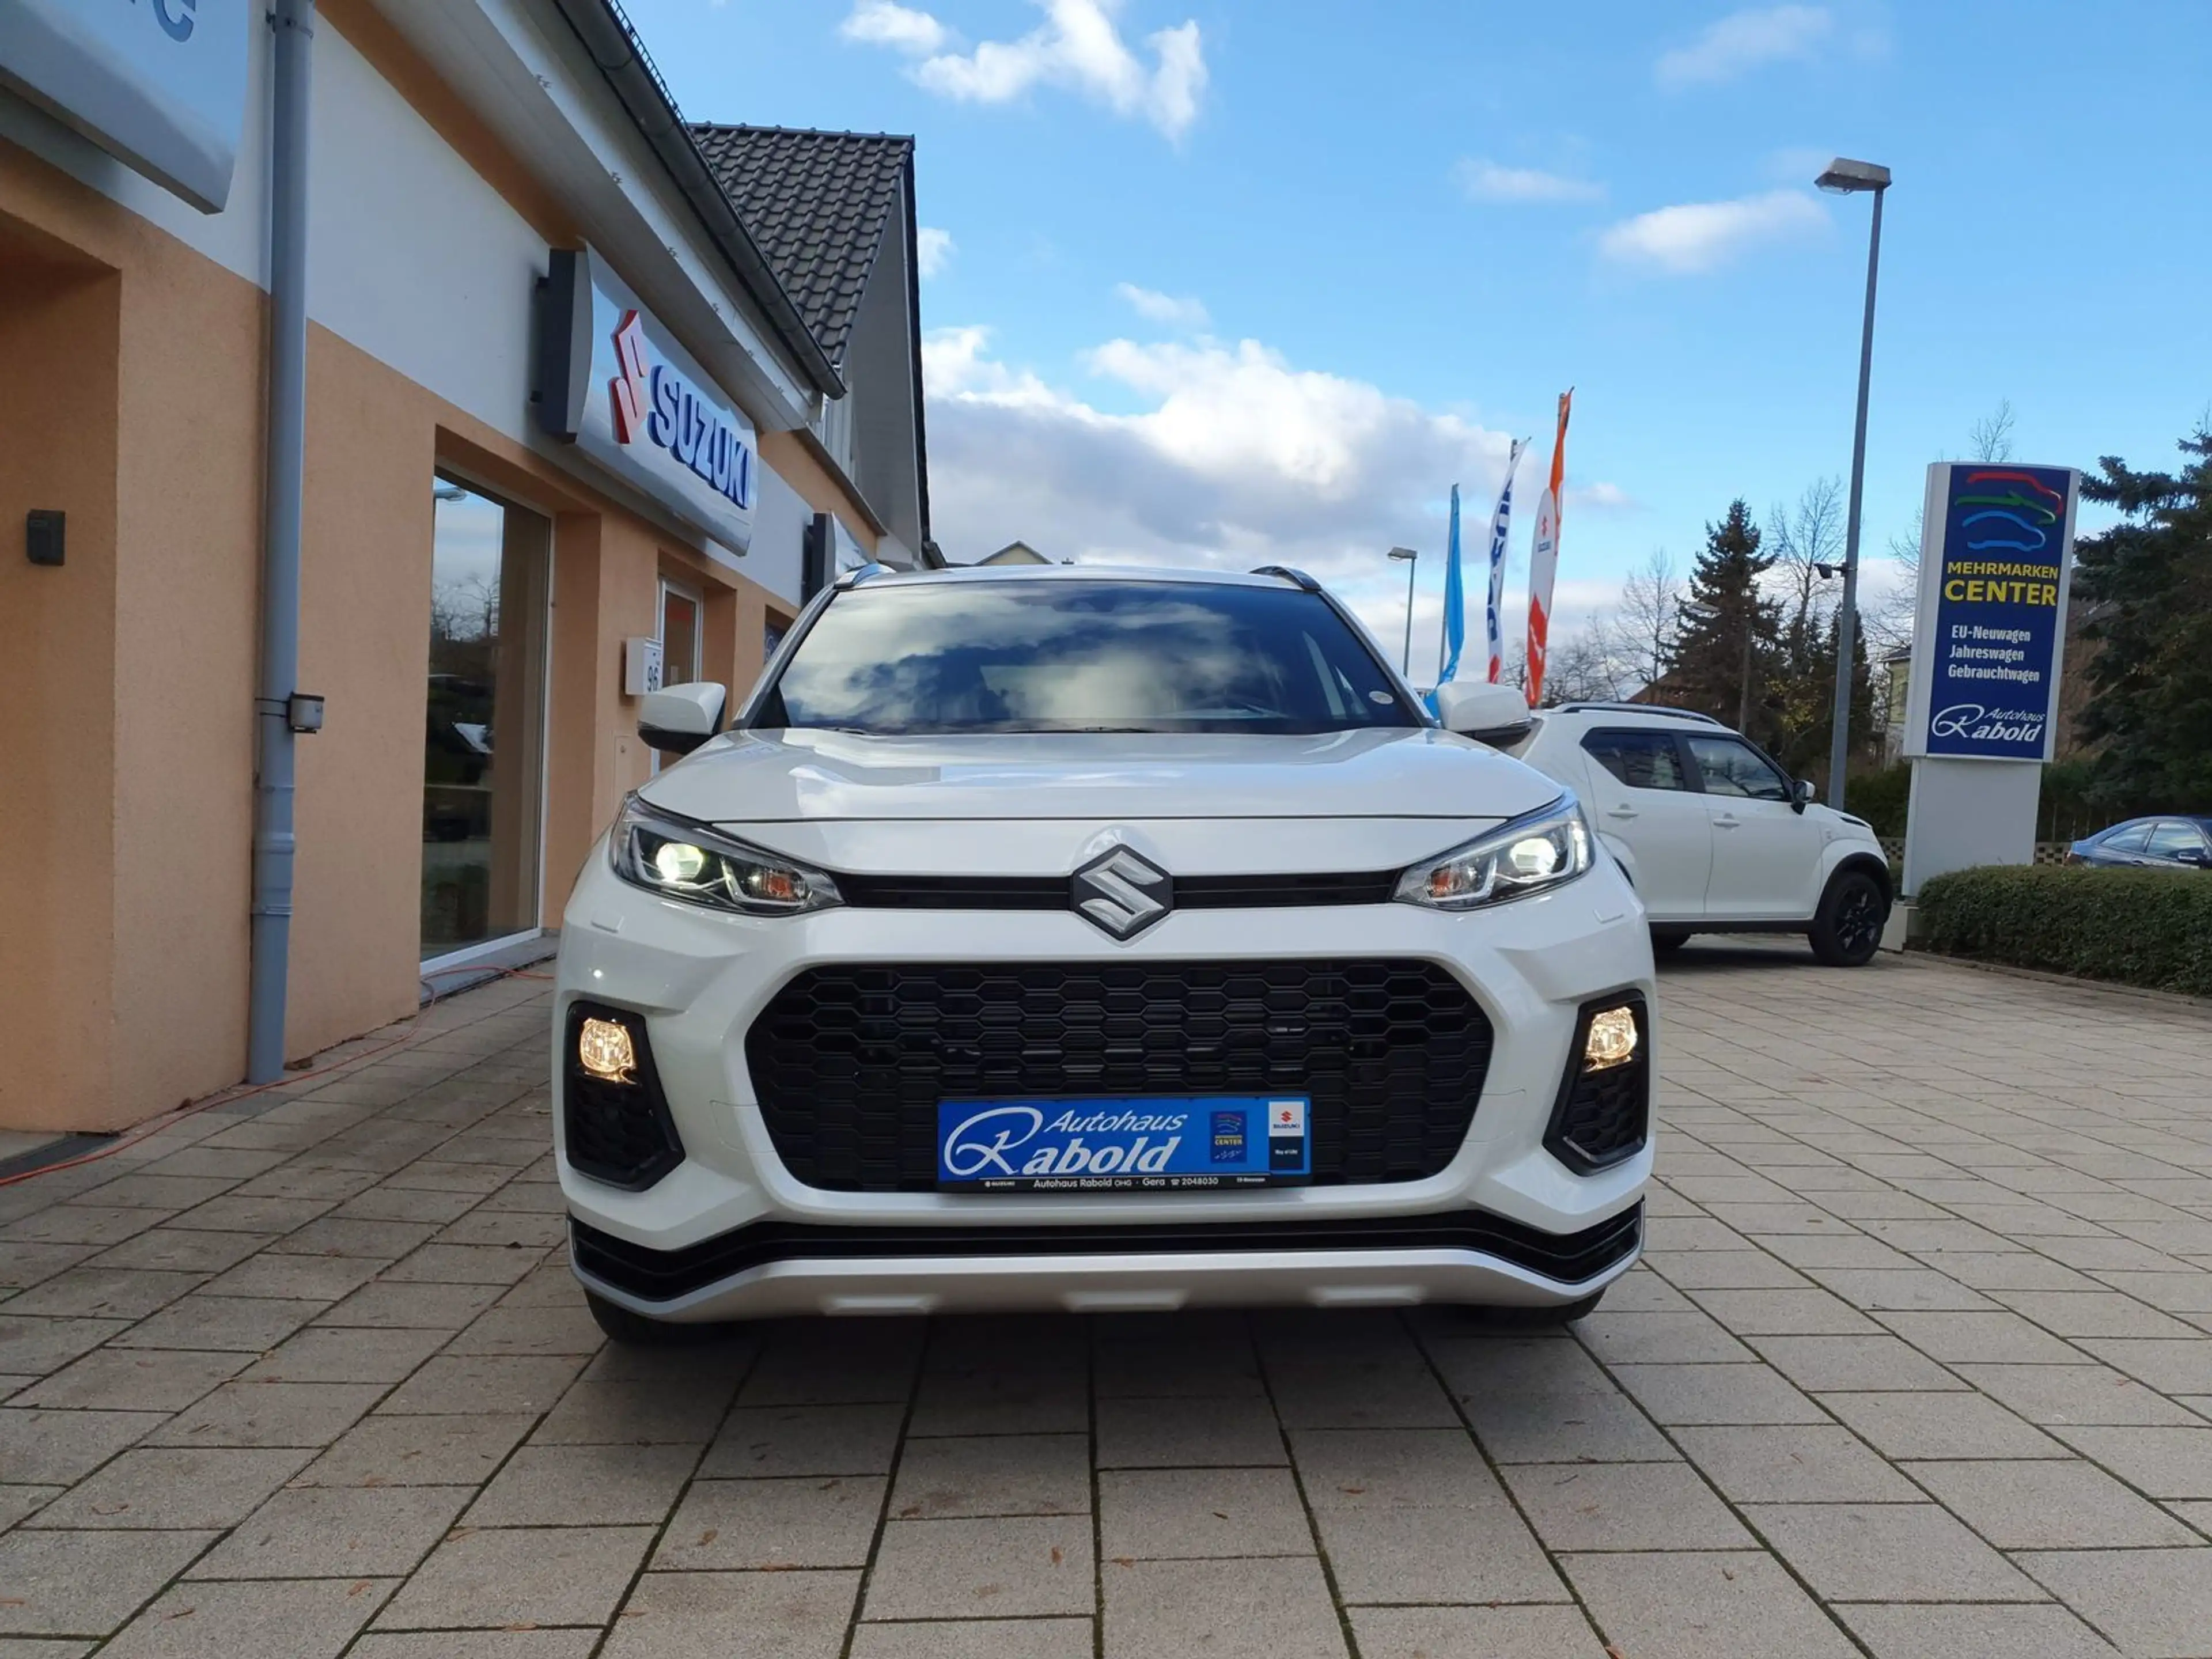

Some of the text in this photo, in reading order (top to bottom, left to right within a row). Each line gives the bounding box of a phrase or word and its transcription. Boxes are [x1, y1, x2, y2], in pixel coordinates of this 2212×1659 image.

[647, 365, 748, 510] SUZUKI
[1947, 561, 2058, 579] MEHRMARKEN
[1944, 579, 2056, 607] CENTER
[1951, 624, 2031, 642] EU-Neuwagen
[1949, 645, 2025, 662] Jahreswagen
[1948, 664, 2040, 683] Gebrauchtwagen
[1931, 703, 2043, 742] Rabold
[1984, 707, 2044, 723] Autohaus
[1043, 1109, 1188, 1134] Autohaus
[944, 1106, 1182, 1176] Rabold
[1033, 1179, 1078, 1188] Autohaus
[1080, 1178, 1112, 1187] Rabold
[1142, 1177, 1165, 1186] Gera
[1181, 1176, 1219, 1185] 2048030
